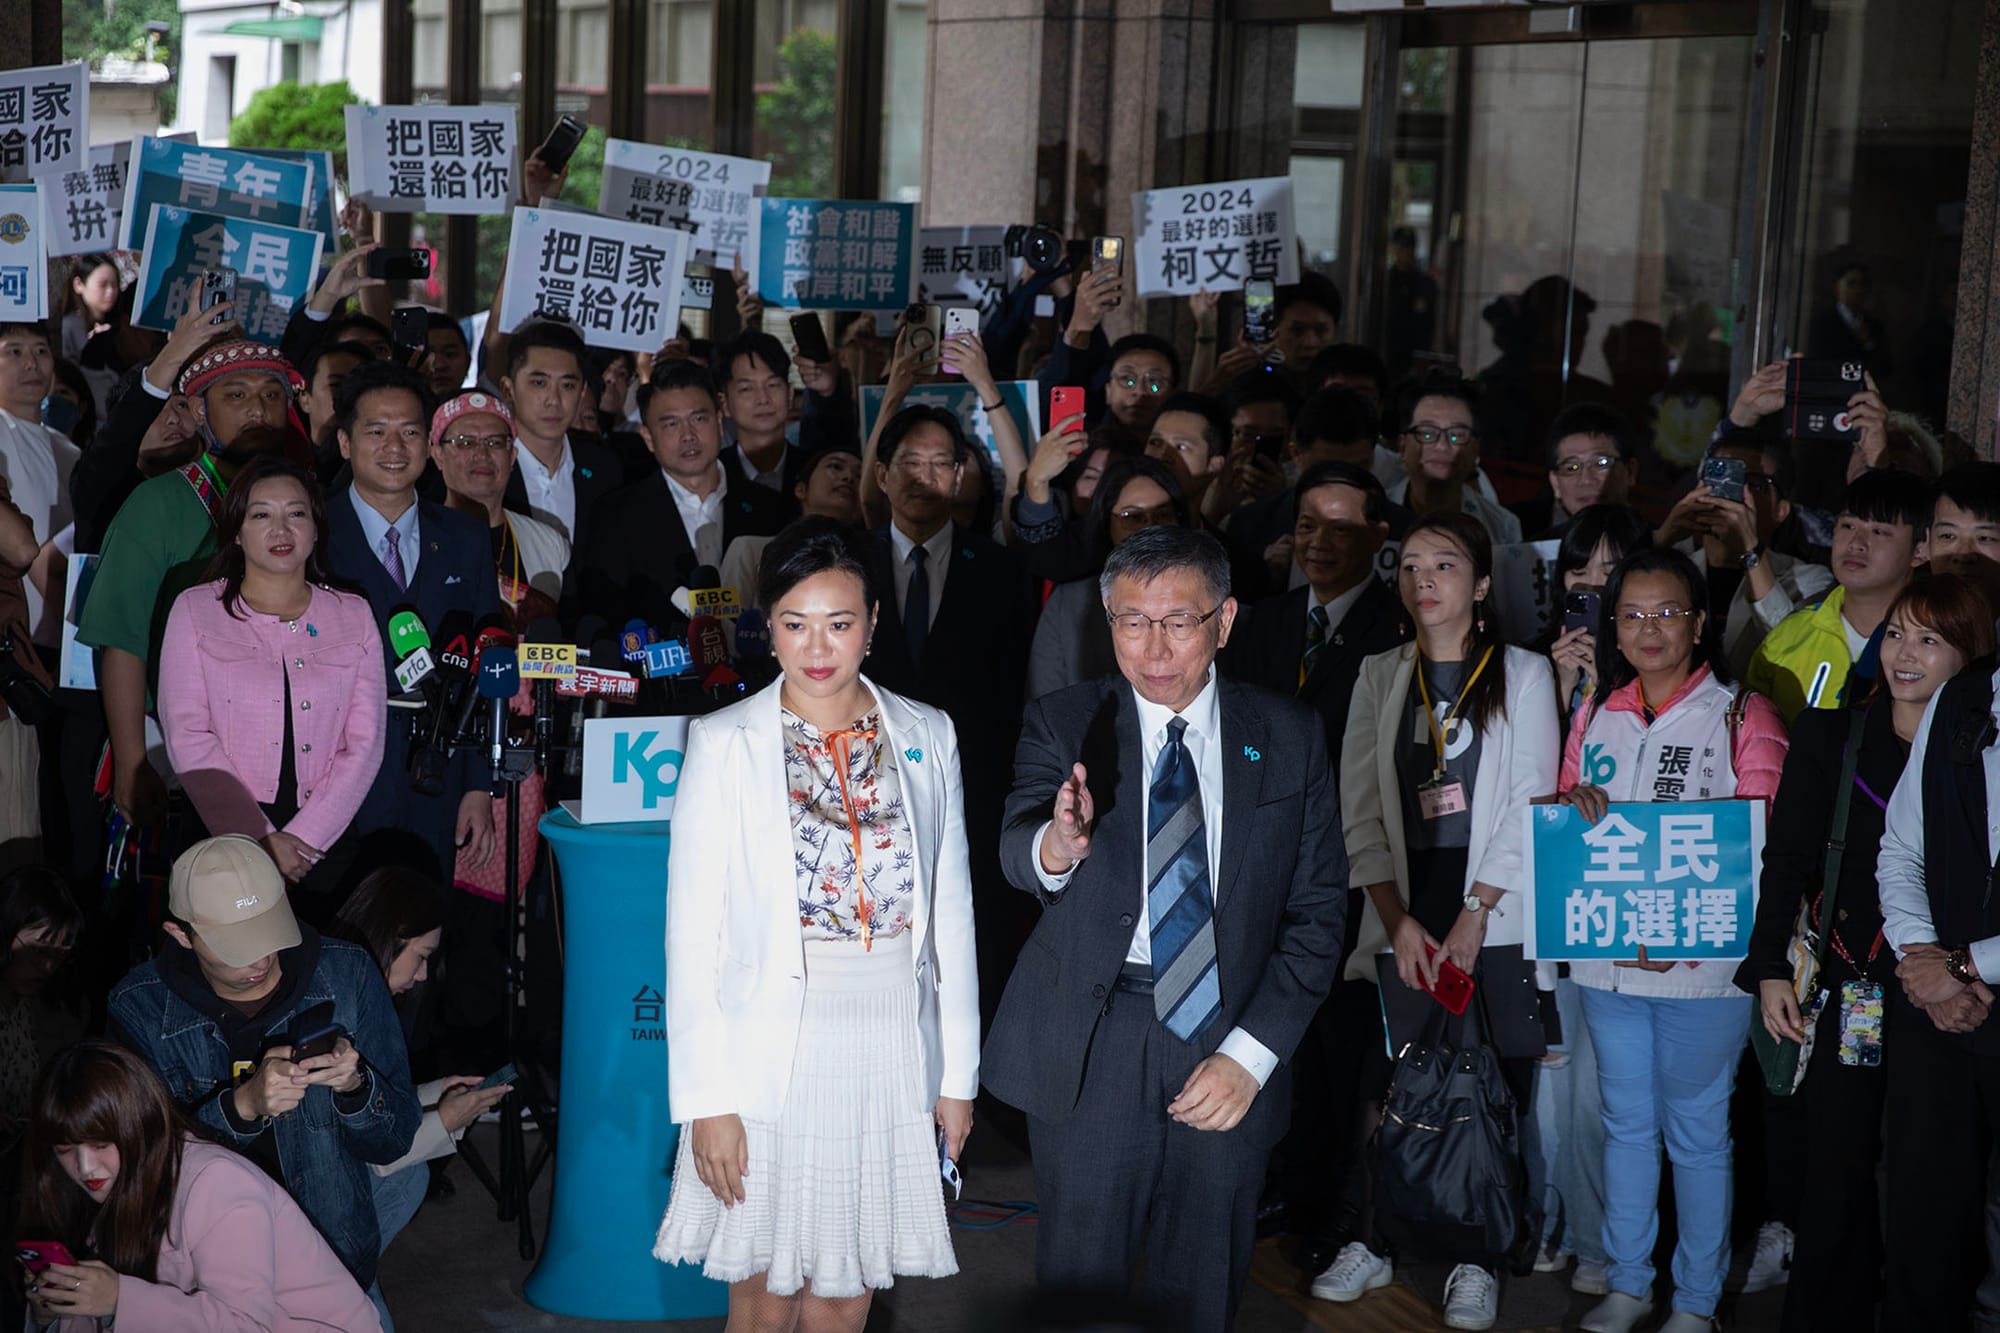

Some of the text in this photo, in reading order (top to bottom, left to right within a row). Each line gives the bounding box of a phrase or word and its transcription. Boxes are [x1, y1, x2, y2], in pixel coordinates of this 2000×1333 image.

[0, 82, 72, 124] 國家
[0, 124, 72, 167] 給你
[386, 118, 505, 157] 把國家
[62, 159, 129, 197] 義無
[178, 152, 281, 217] 青年
[389, 160, 509, 199] 還給你
[656, 154, 730, 184] 2024
[629, 177, 750, 217] 最好的選擇
[1182, 188, 1254, 214] 2024
[786, 205, 901, 239] 社會和諧
[1161, 212, 1277, 243] 最好的選擇
[187, 222, 290, 290] 全民
[539, 228, 666, 288] 把國家
[784, 238, 898, 271] 政黨和解
[1161, 238, 1282, 288] 柯文哲
[781, 269, 896, 301] 兩岸和平
[532, 276, 660, 336] 還給你
[695, 591, 733, 605] EBC
[441, 652, 469, 670] cna
[527, 647, 569, 661] EBC
[624, 650, 646, 662] NTD
[701, 626, 727, 665] 台視
[406, 656, 427, 680] rfa
[1581, 813, 1720, 883] 全民
[235, 896, 258, 909] FILA
[1565, 888, 1738, 948] 的選擇
[632, 984, 665, 1022] 台
